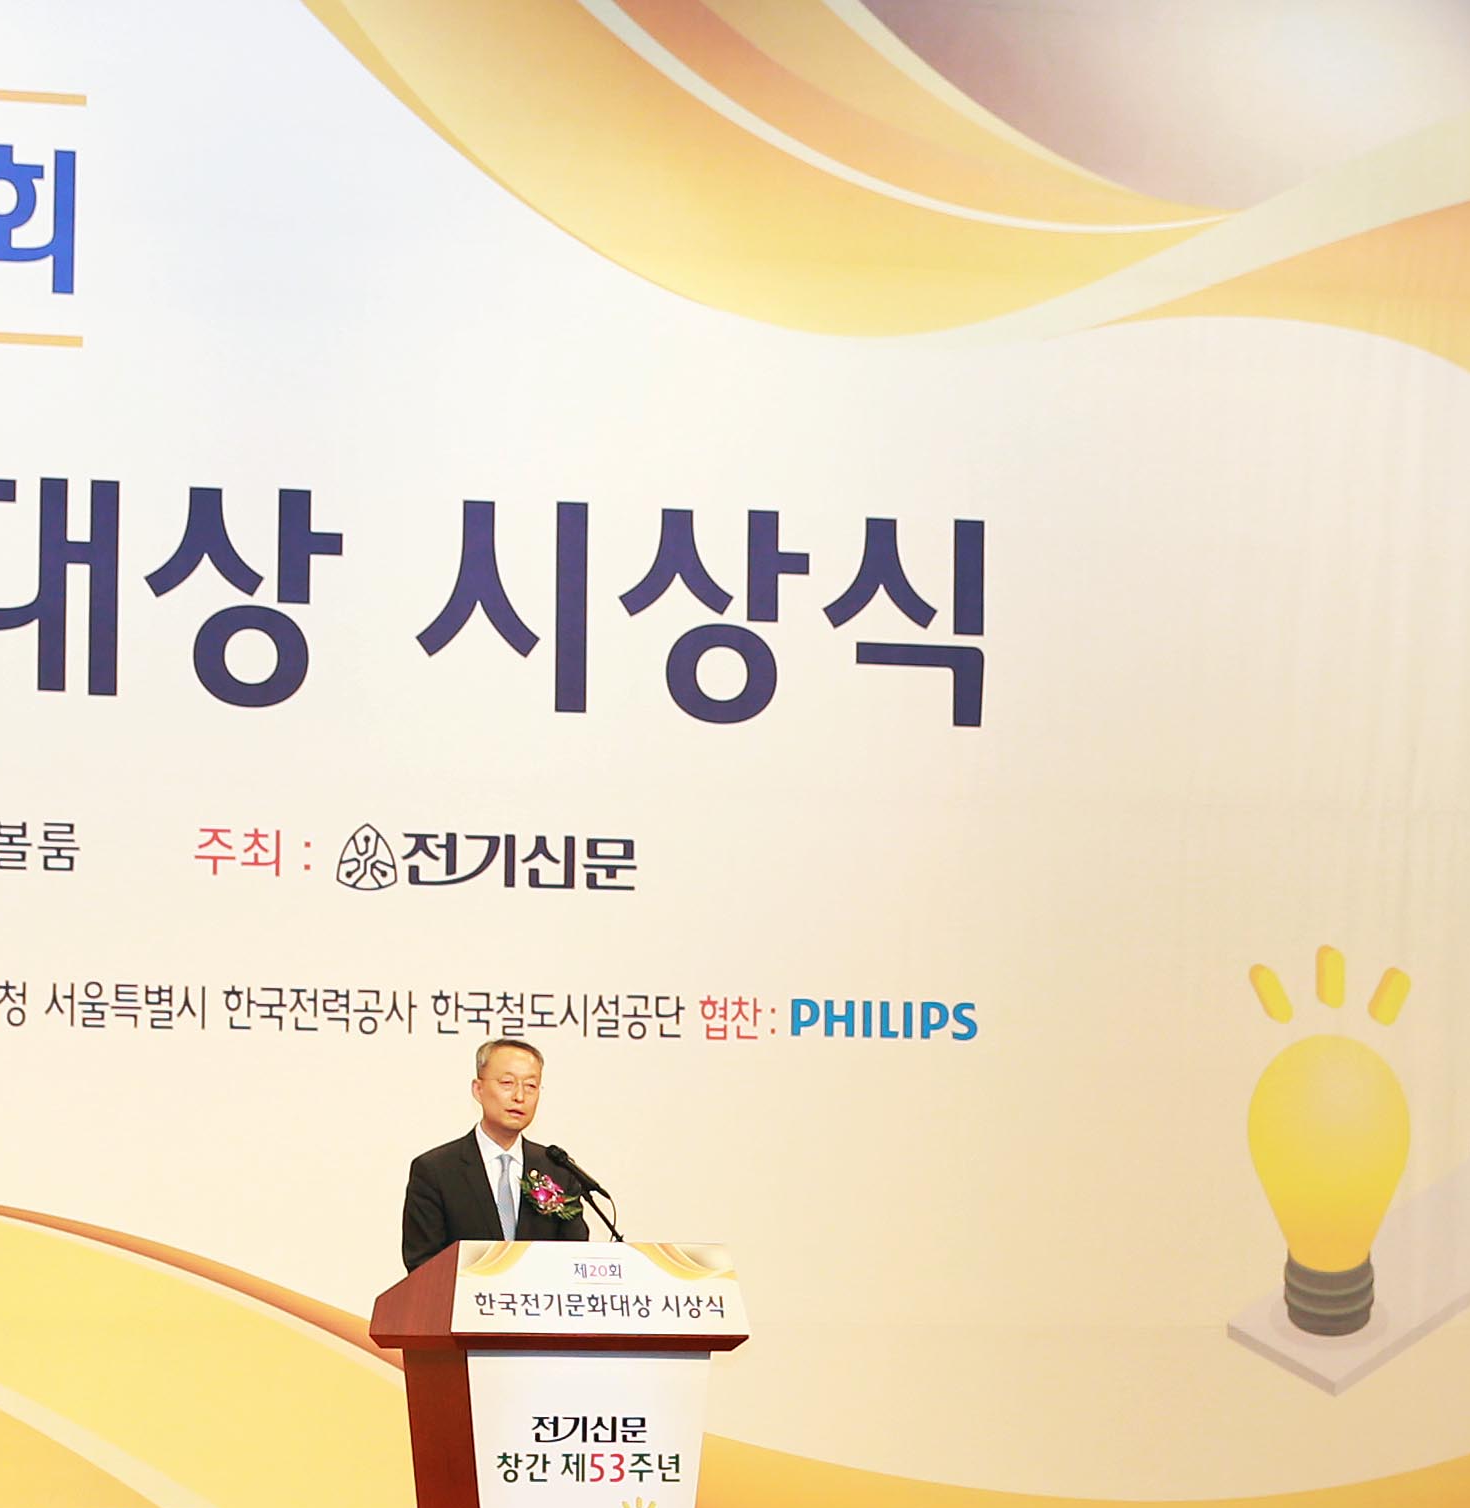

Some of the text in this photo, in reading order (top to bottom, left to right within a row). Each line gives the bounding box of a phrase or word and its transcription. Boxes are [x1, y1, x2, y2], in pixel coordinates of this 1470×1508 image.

[415, 499, 987, 729] 시상식
[401, 832, 638, 892] 전기신문
[44, 980, 207, 1031] 서울특별시
[222, 984, 418, 1036] 한국전력공사
[430, 989, 687, 1041] 한국철도시설공단
[790, 998, 979, 1042] PHILIPS
[573, 1262, 623, 1279] 제20회
[474, 1291, 726, 1319] 한국전기문화대상 시상식
[531, 1415, 648, 1444] 전기신문
[496, 1451, 682, 1484] 창간 제53주년
